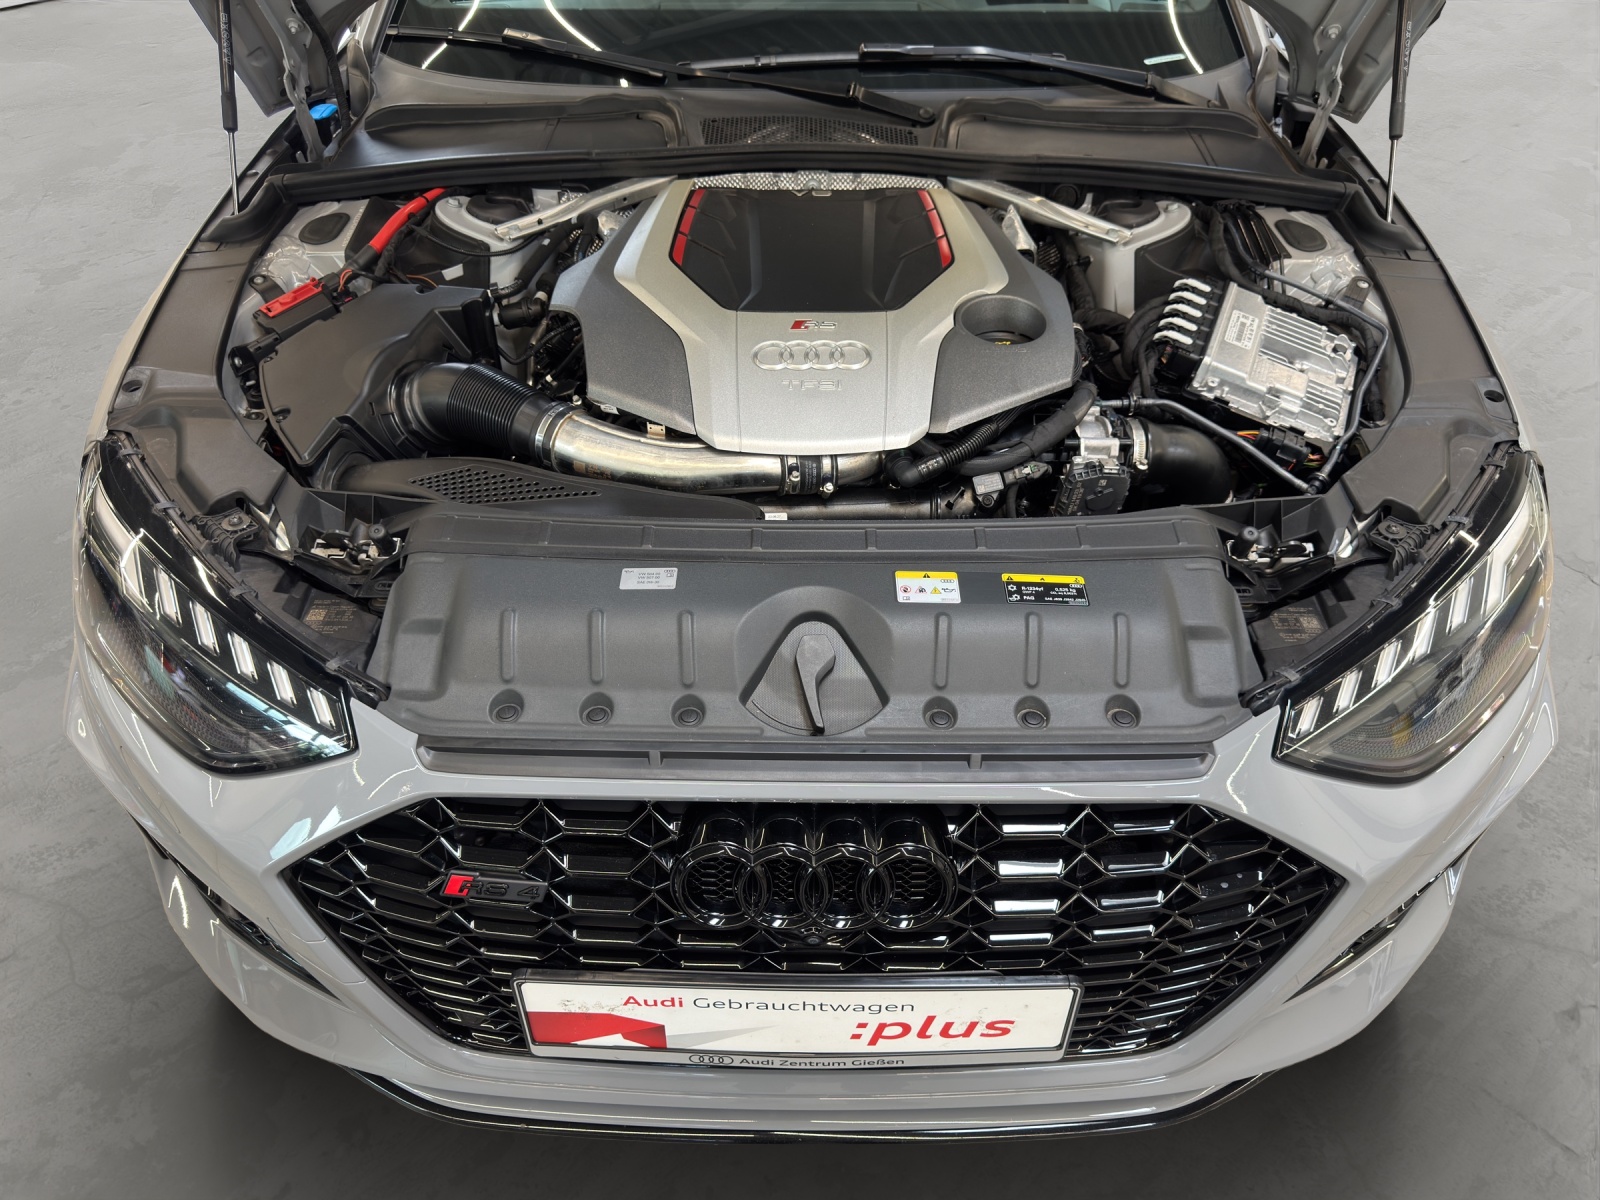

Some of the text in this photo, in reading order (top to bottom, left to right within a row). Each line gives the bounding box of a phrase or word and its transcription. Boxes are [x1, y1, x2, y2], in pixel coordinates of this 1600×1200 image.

[795, 320, 837, 330] RS
[782, 380, 842, 391] TFSI
[451, 877, 540, 899] RS 4
[623, 996, 915, 1015] Audi Gebrauchtwagen
[850, 1015, 1016, 1046] :plus
[739, 1058, 905, 1067] Audi Zentrum Gießen
